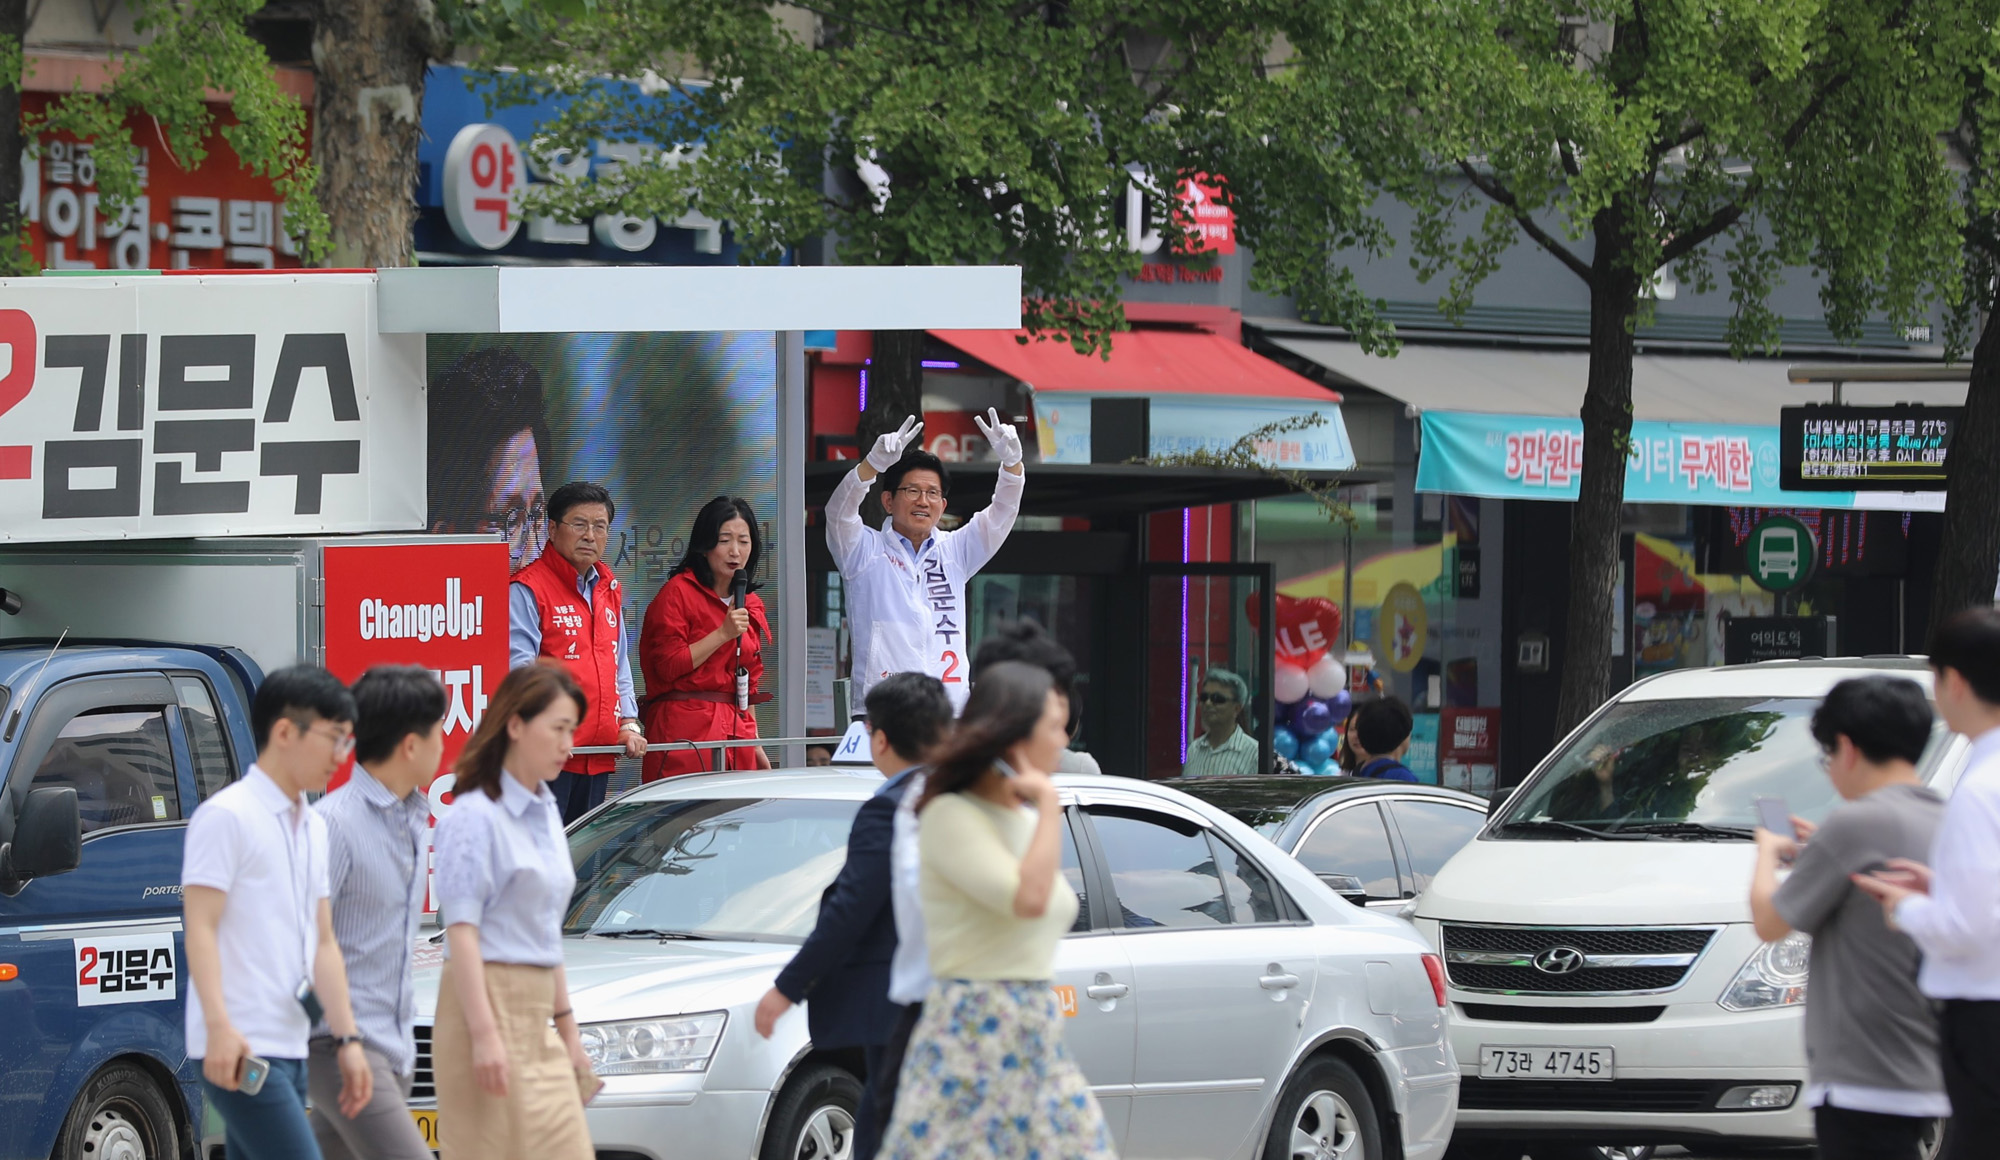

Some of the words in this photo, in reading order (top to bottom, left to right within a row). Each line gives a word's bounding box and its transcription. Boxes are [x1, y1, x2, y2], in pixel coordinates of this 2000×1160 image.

[471, 143, 514, 231] 약
[42, 333, 361, 519] 김문수
[1629, 436, 1675, 484] 이터
[1680, 436, 1752, 490] 무제한
[923, 558, 961, 645] 김문수
[1750, 629, 1801, 649] 여의도역
[940, 650, 962, 683] 2
[99, 947, 173, 994] 김문수
[1492, 1050, 1533, 1074] 73라
[1544, 1051, 1601, 1075] 4745
